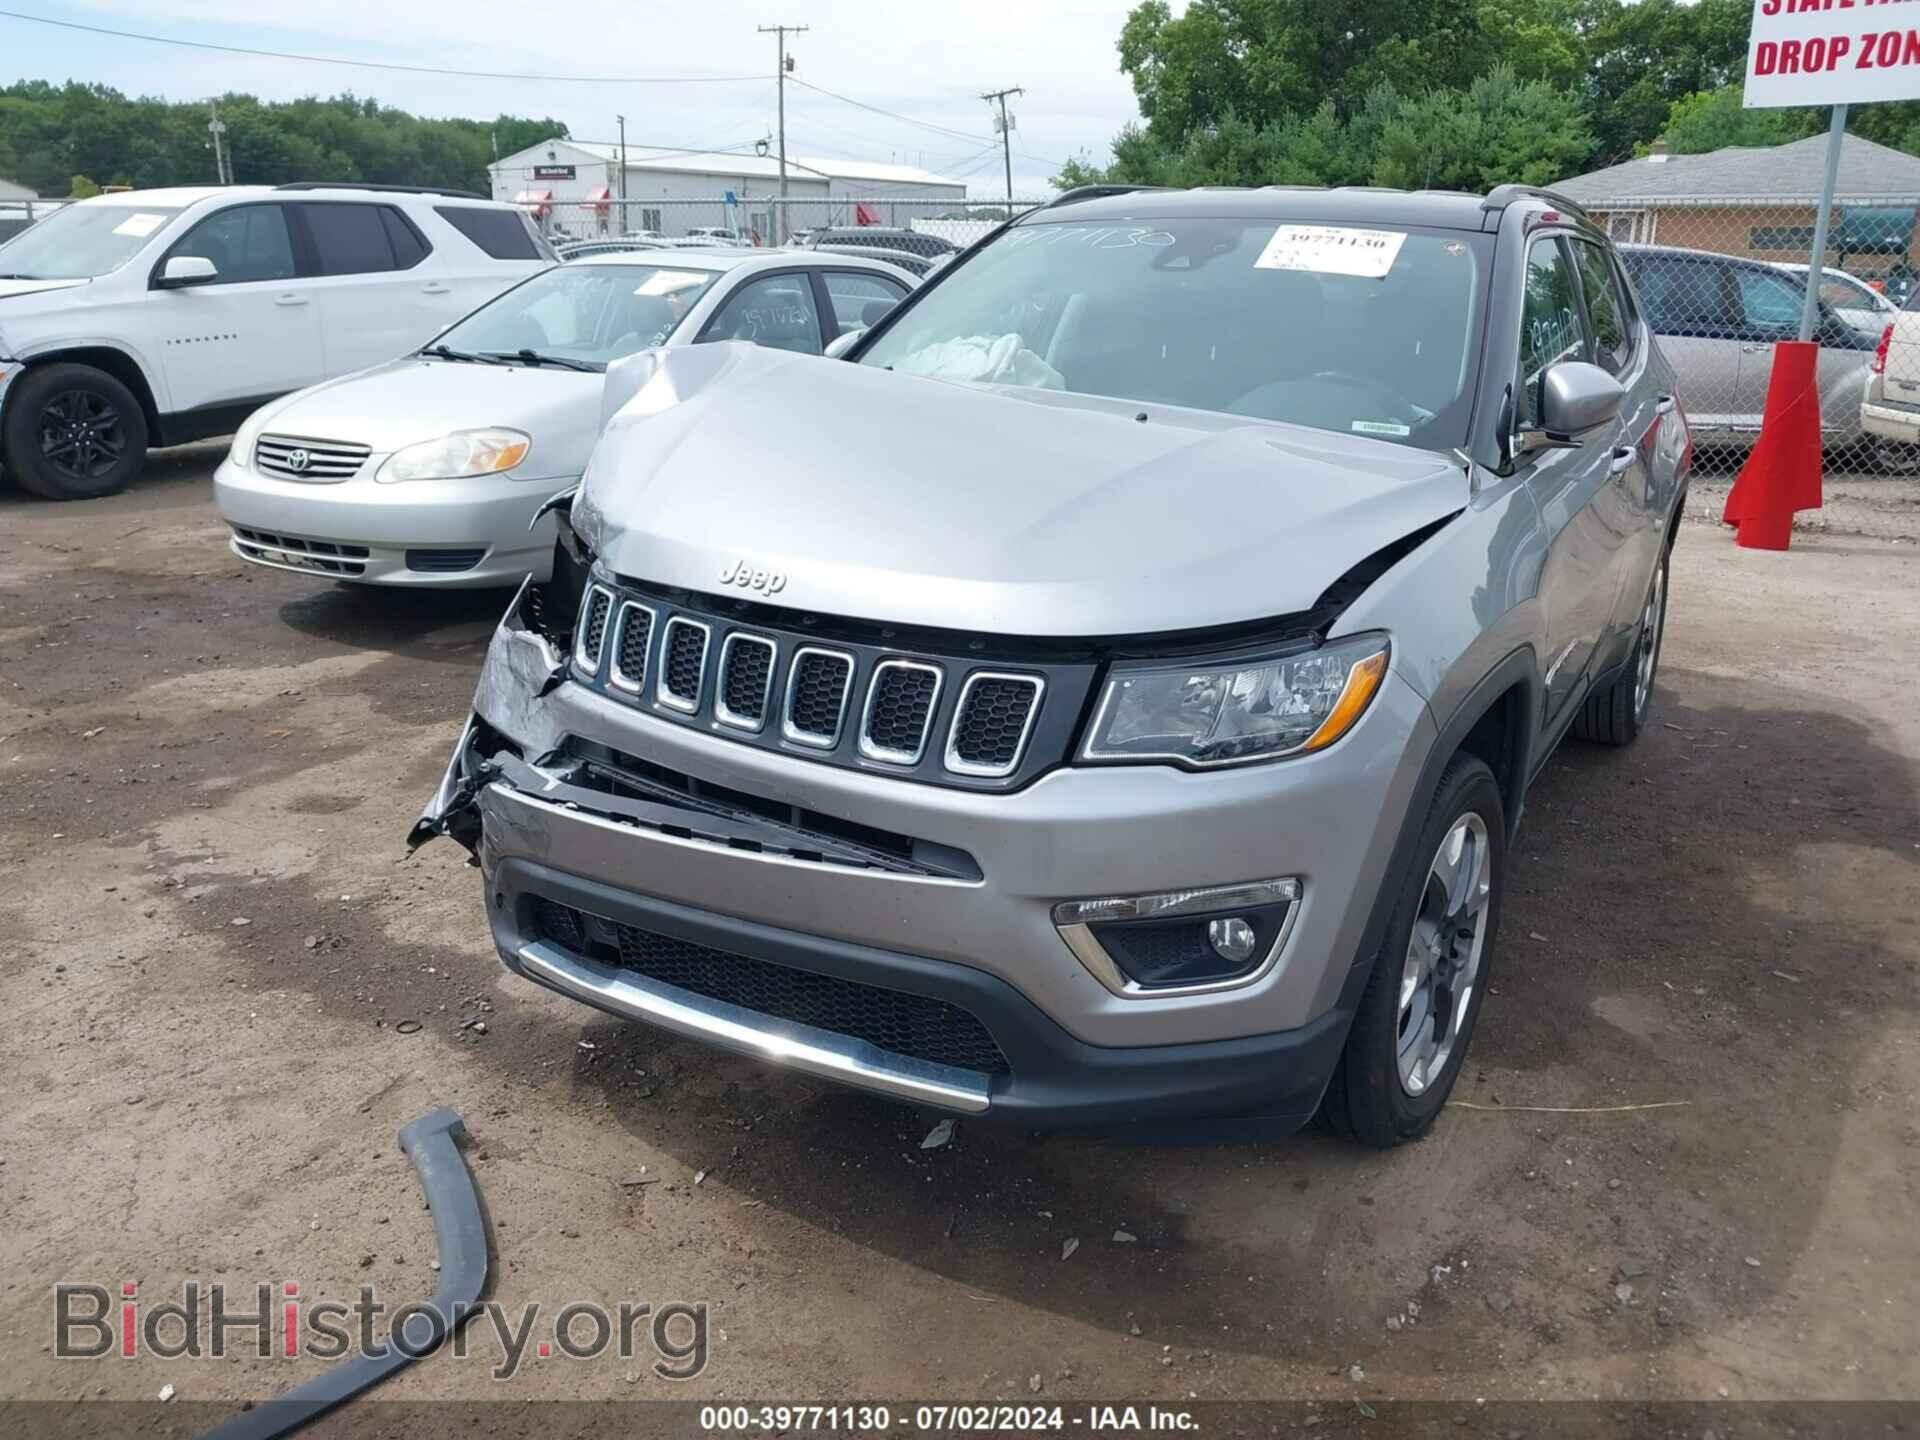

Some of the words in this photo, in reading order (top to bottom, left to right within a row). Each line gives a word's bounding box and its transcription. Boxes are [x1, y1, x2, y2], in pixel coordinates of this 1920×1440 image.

[1754, 36, 1850, 76] DROP
[1289, 232, 1387, 249] 39771130
[718, 559, 788, 598] Jeep
